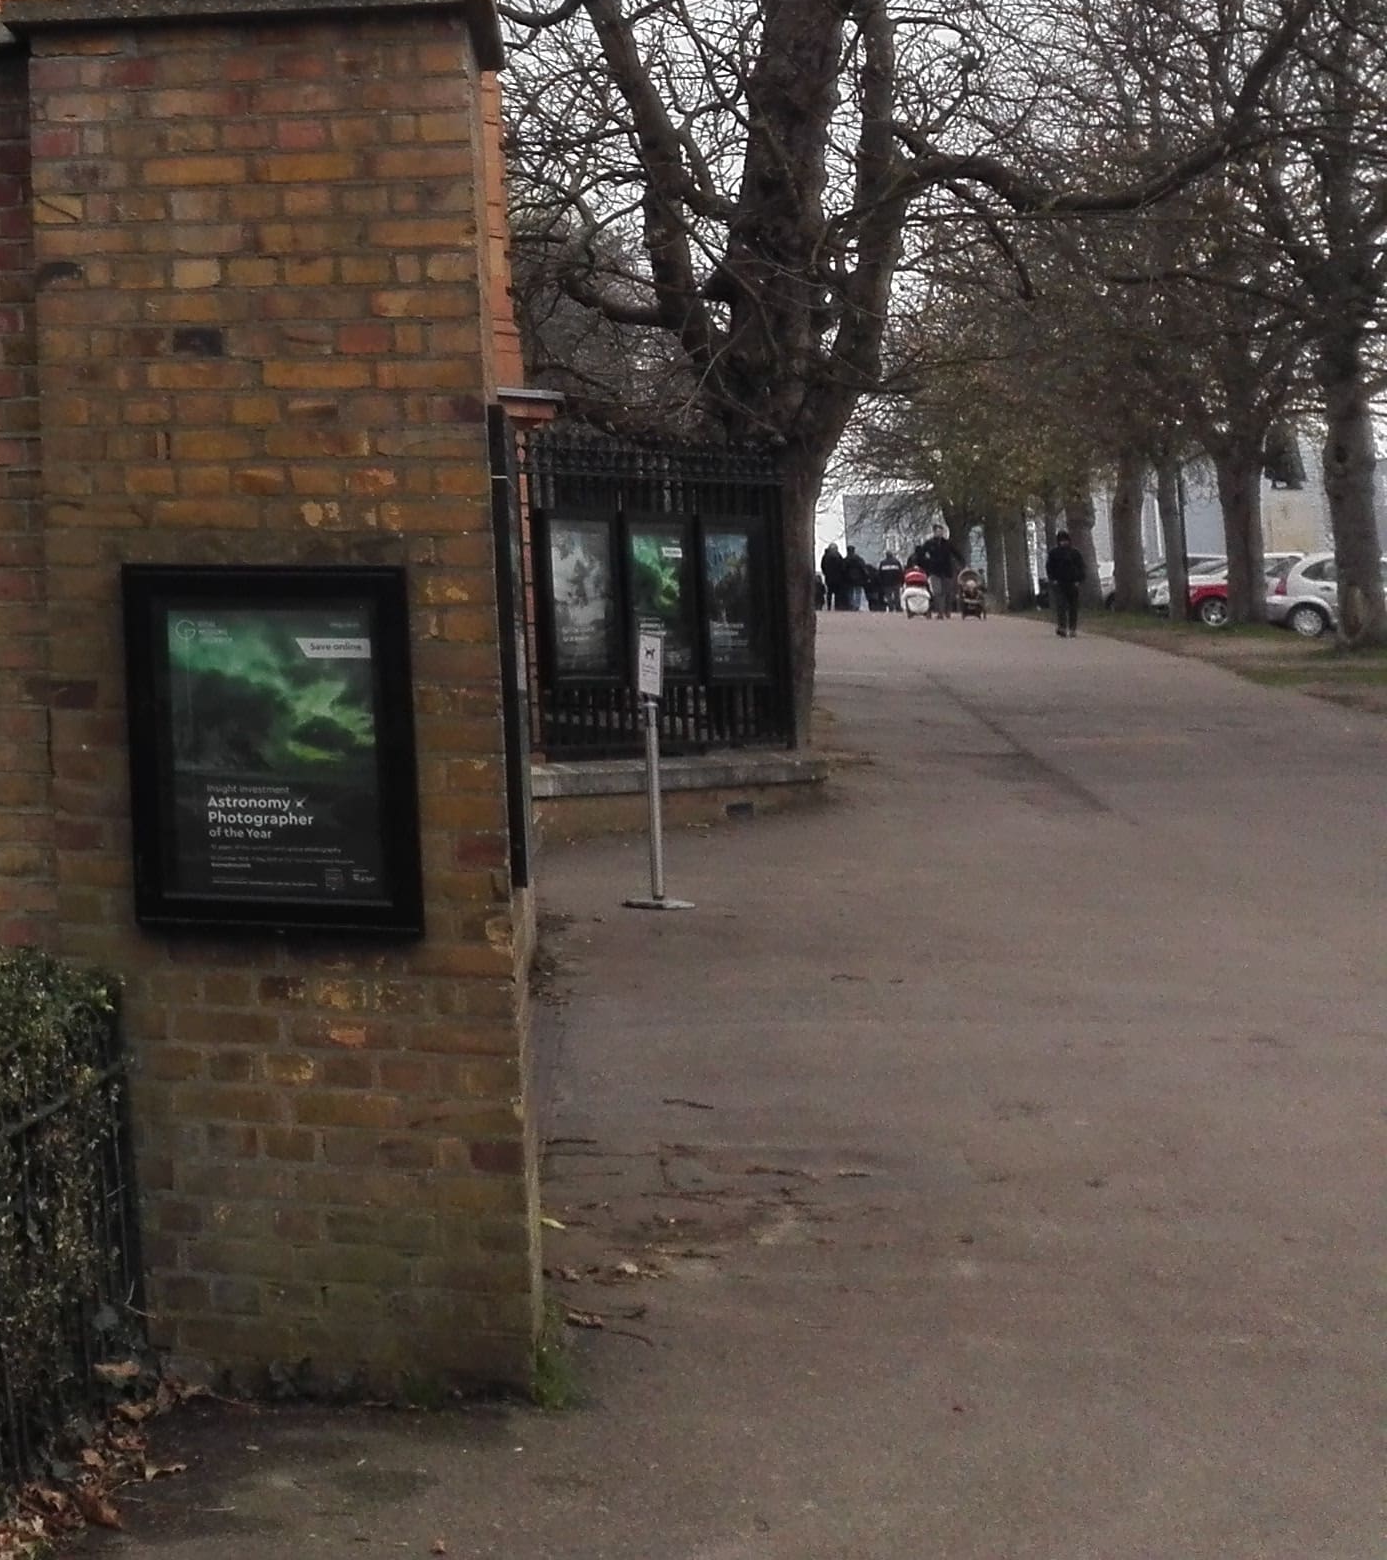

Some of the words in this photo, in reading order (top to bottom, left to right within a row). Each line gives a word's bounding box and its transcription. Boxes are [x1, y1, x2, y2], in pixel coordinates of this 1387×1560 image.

[310, 642, 331, 651] Save
[332, 642, 362, 652] online
[207, 795, 291, 812] Astronomy
[208, 809, 314, 827] Photographer
[209, 826, 222, 838] of
[223, 826, 244, 838] the
[246, 827, 273, 839] Year
